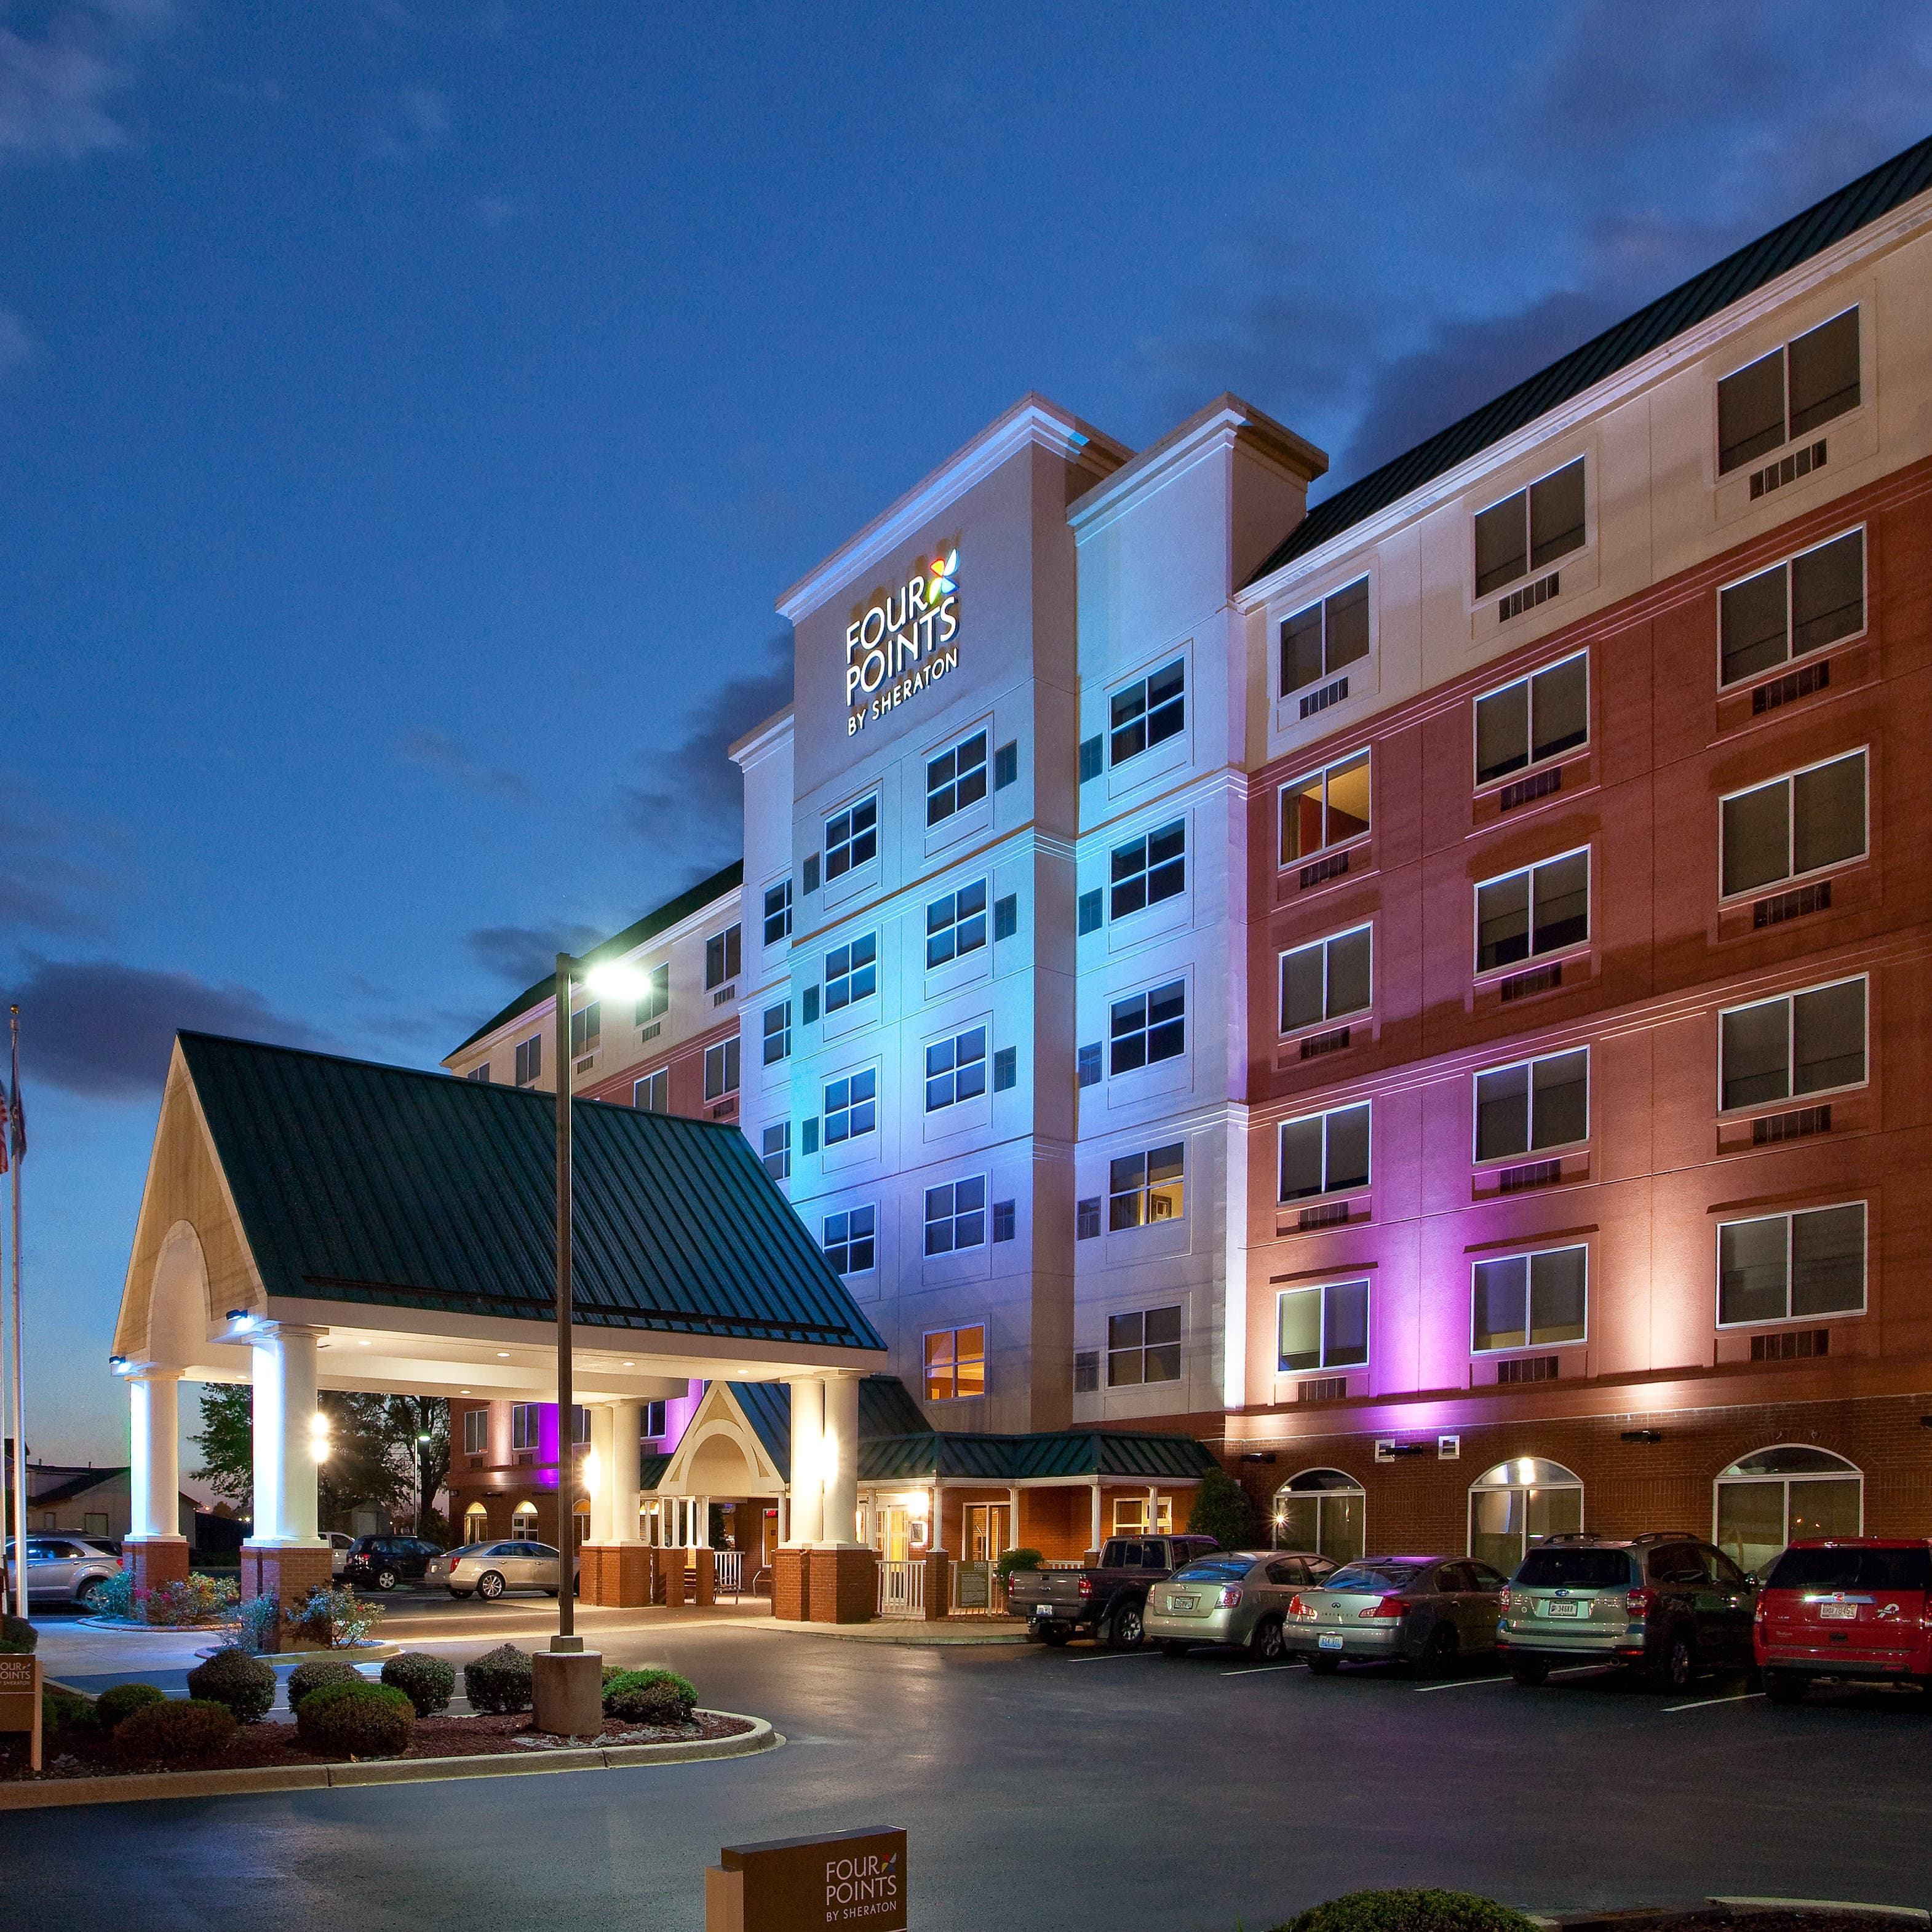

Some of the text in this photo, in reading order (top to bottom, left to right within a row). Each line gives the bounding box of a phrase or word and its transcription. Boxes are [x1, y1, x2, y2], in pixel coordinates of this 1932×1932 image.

[846, 576, 929, 665] FOUR
[846, 596, 958, 707] POINTS
[848, 648, 958, 737] BY SHERATON
[0, 1662, 22, 1671] OUR
[0, 1671, 31, 1679] OINTS
[826, 1855, 880, 1883] FOUR
[826, 1875, 897, 1906] POINTS
[826, 1901, 896, 1922] BY SHERATON
